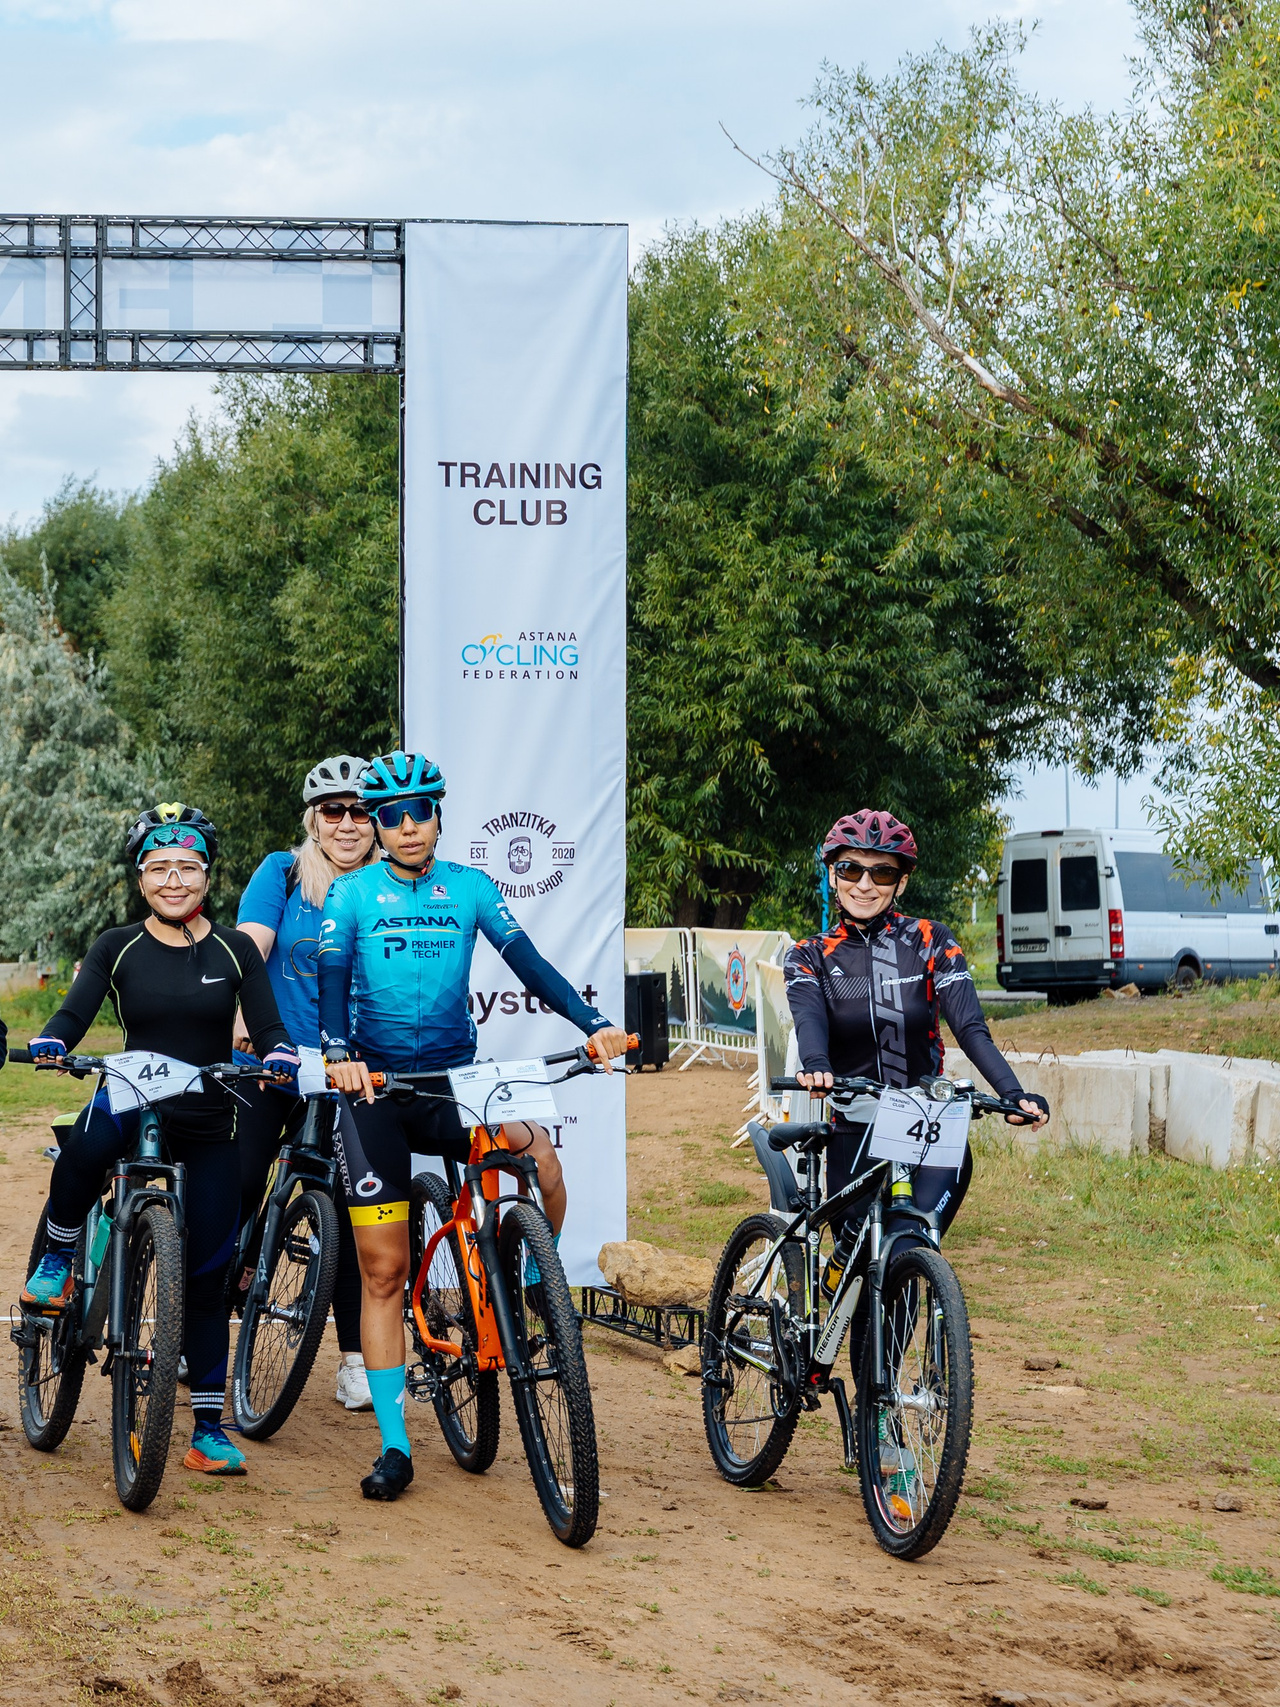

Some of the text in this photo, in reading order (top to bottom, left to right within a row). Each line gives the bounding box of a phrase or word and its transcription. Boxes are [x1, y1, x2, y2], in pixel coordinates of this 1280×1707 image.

[437, 461, 602, 489] TRAINING
[473, 499, 568, 526] CLUB
[518, 631, 578, 641] ASTANA
[461, 643, 579, 666] CYCLING
[463, 669, 579, 680] FEDERATION
[481, 811, 557, 839] TRANZITKA
[470, 847, 575, 859] EST. 2020
[536, 870, 564, 895] SHOP
[371, 916, 462, 932] ASTANA
[411, 940, 455, 948] PREMIER
[412, 950, 440, 958] TECH
[881, 973, 923, 987] MERIDA
[138, 1063, 170, 1081] 44
[495, 1081, 512, 1102] 3
[889, 1097, 910, 1105] TRAINING
[564, 1116, 578, 1124] TM
[906, 1119, 941, 1144] 48
[335, 1132, 354, 1197] SAMRUK
[816, 1315, 840, 1358] MERIDA
